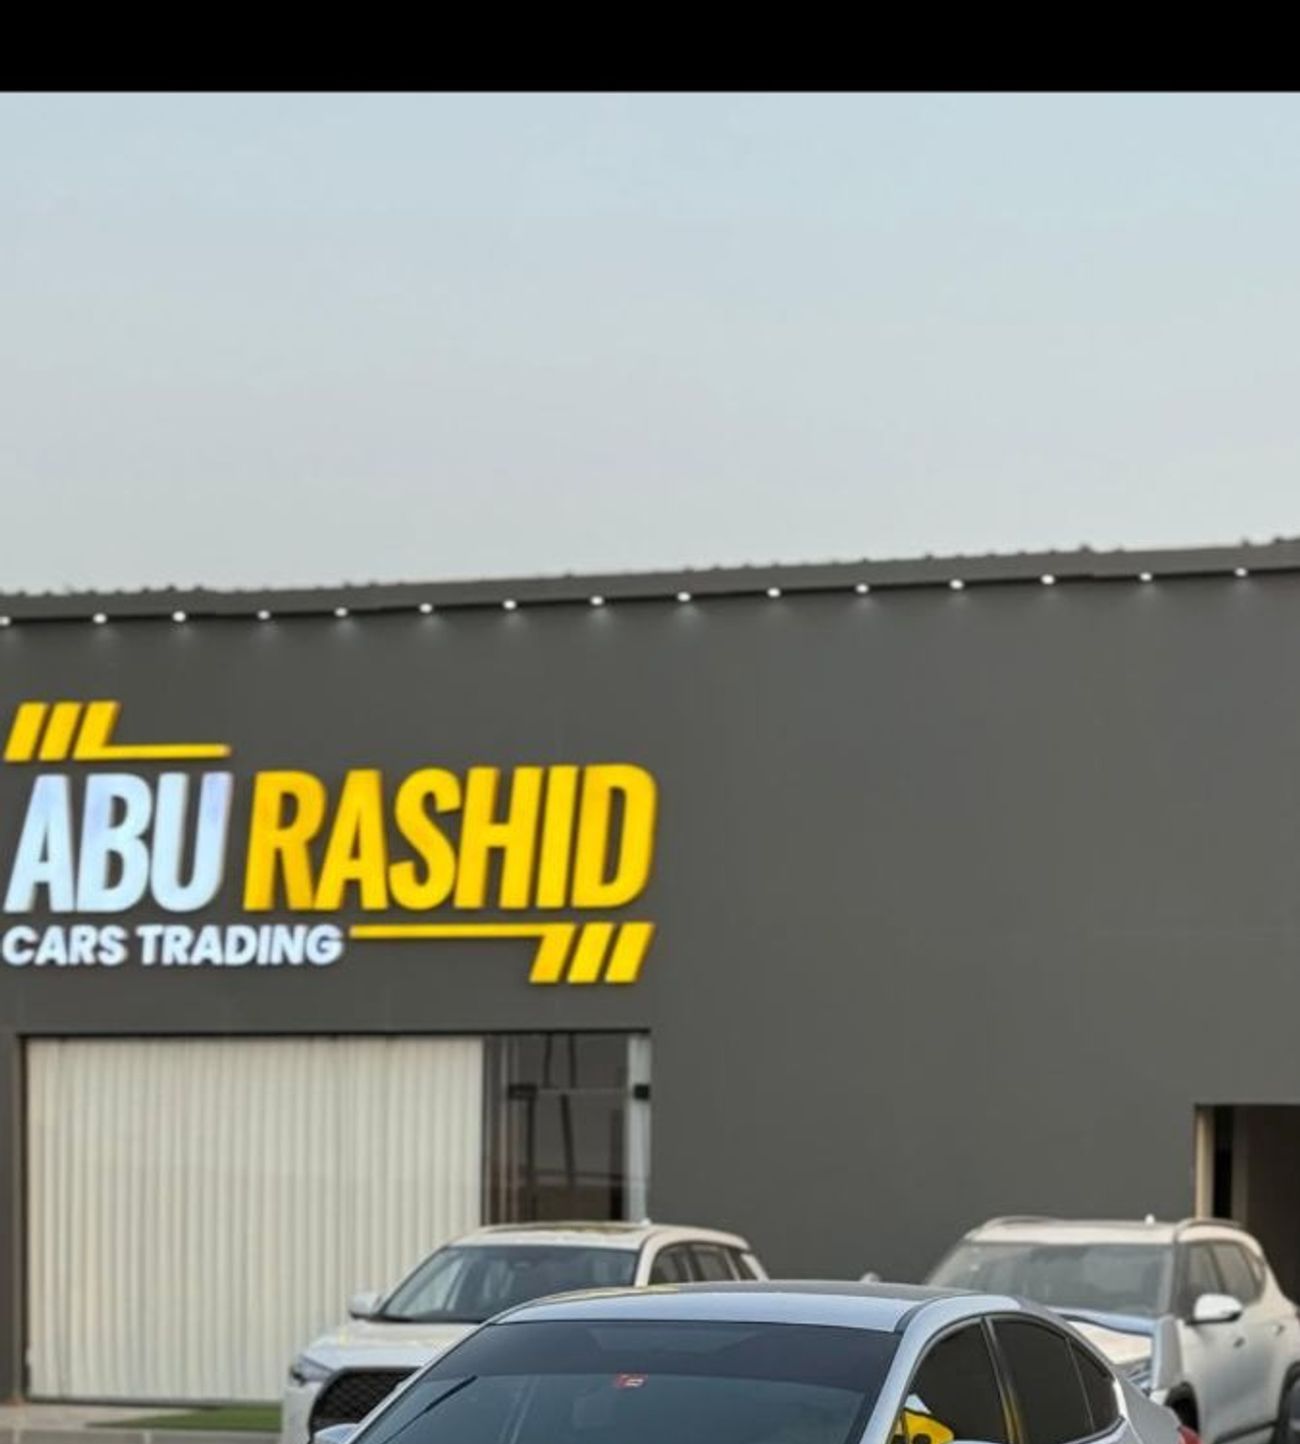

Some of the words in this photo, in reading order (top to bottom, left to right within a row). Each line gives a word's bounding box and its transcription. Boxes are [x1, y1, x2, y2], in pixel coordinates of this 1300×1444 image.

[2, 771, 233, 913] ABU
[242, 763, 657, 912] RASHID
[1, 925, 128, 966] CARS
[135, 924, 344, 966] TRADING
